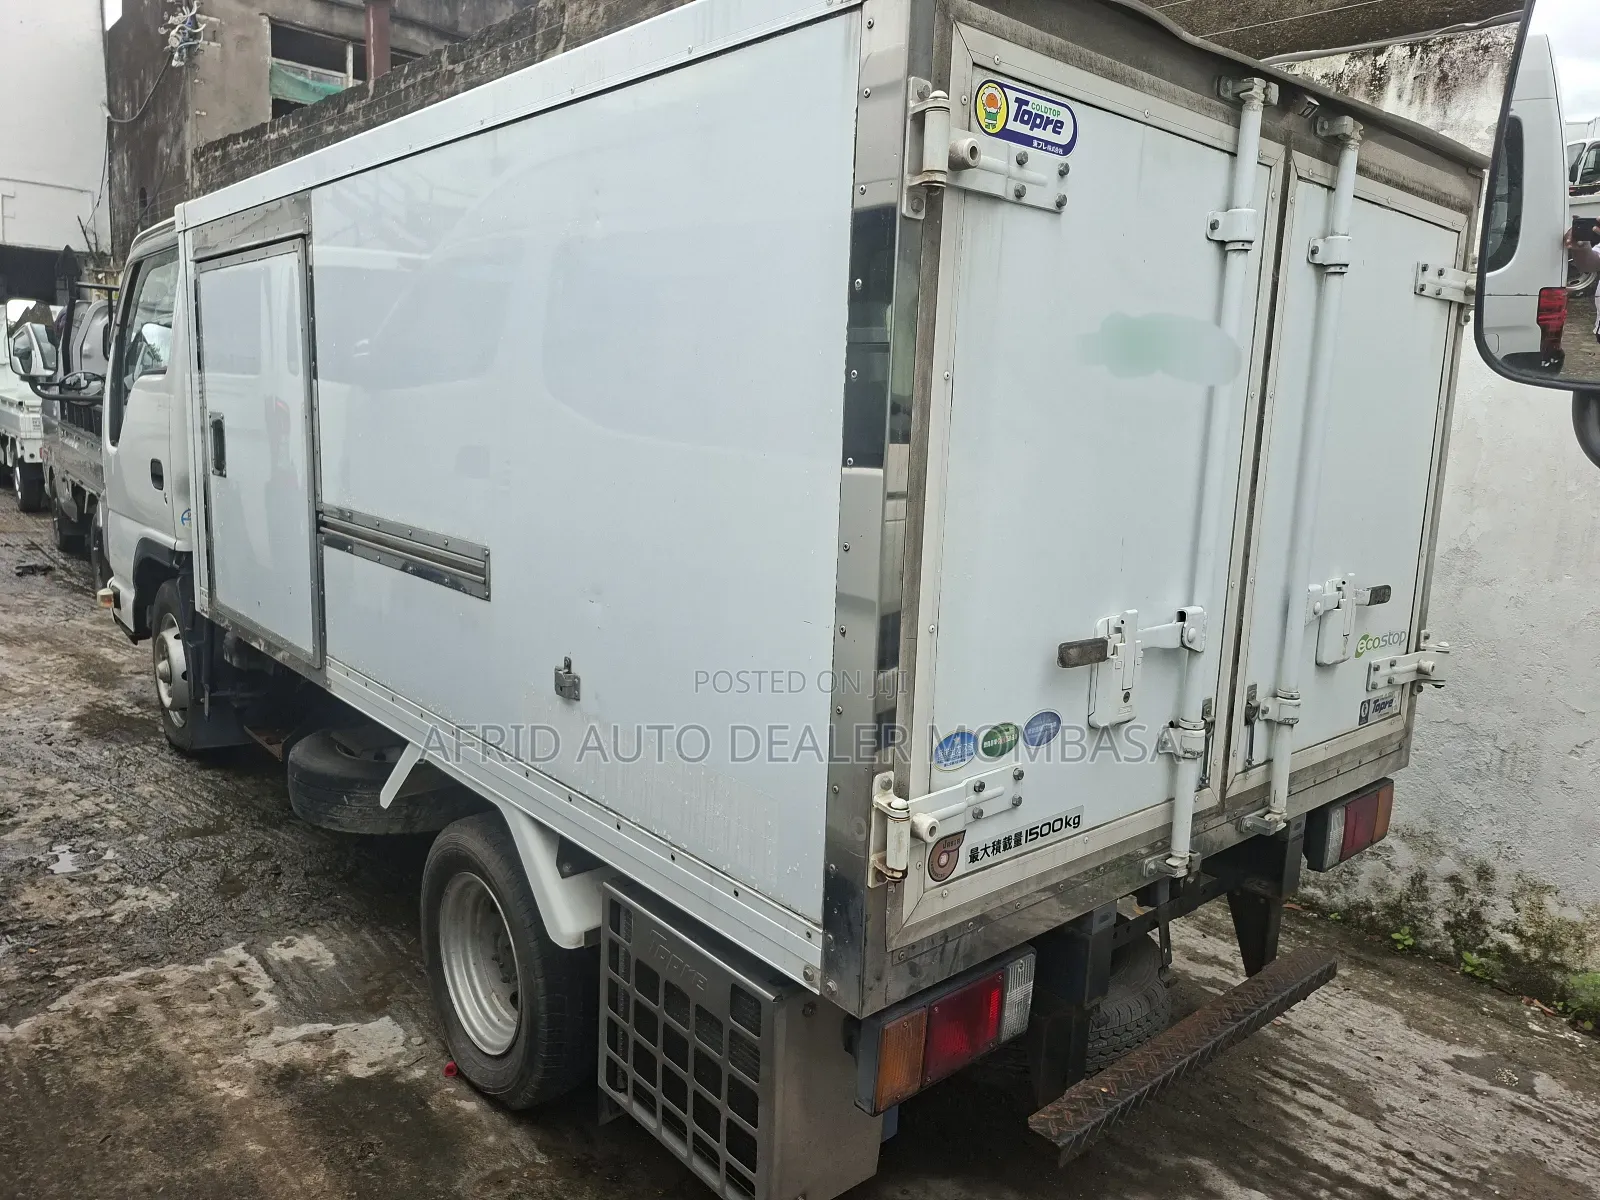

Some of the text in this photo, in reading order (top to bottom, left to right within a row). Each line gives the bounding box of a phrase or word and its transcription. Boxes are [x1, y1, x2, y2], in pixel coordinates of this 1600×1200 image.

[1012, 96, 1064, 135] Topre
[1031, 102, 1061, 118] COLDTOP
[1356, 630, 1407, 652] ecostop
